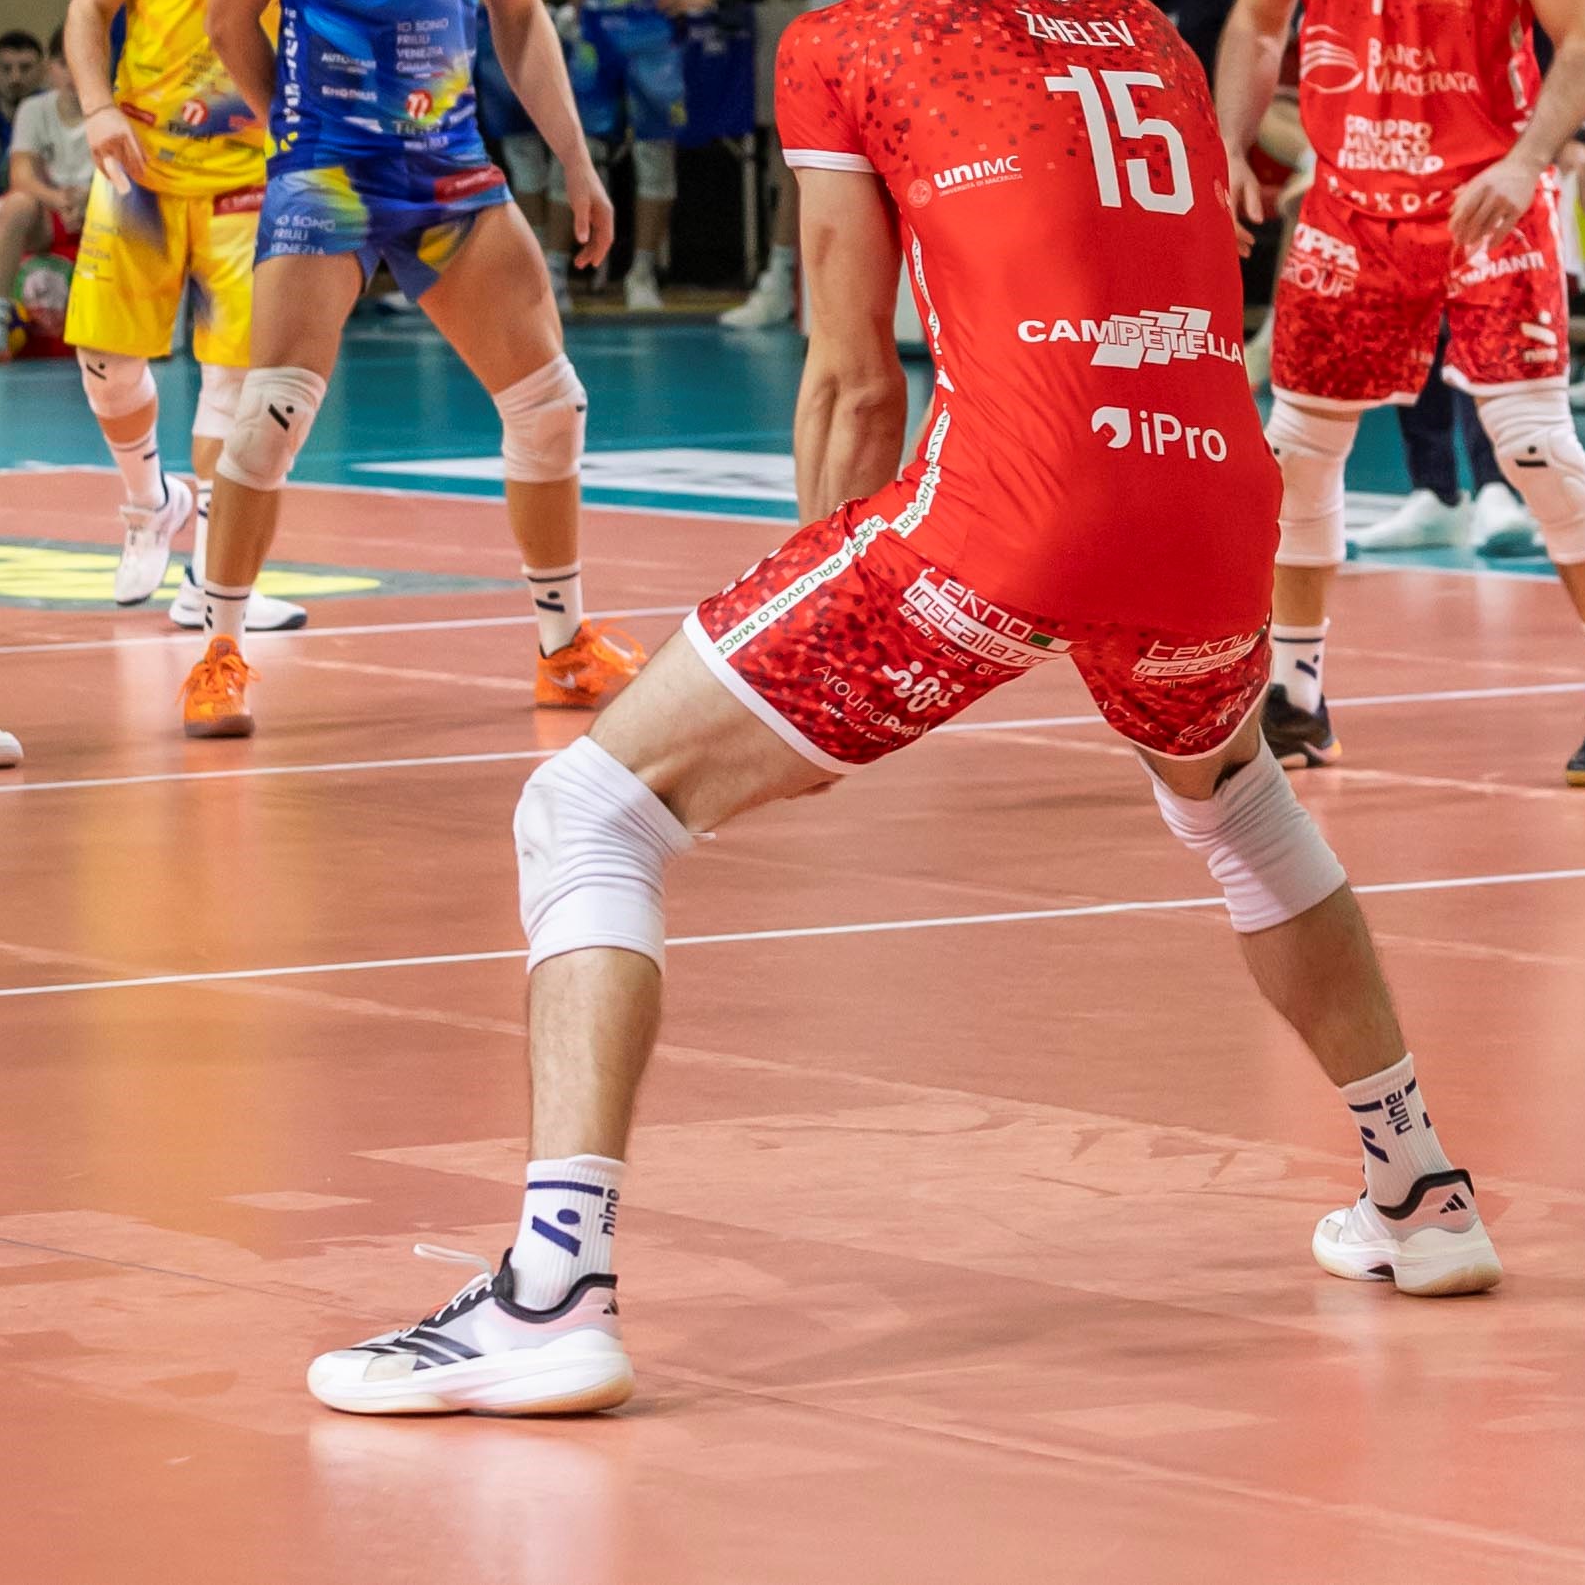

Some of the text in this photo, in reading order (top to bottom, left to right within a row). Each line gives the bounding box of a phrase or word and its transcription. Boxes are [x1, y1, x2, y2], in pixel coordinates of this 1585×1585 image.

[1017, 10, 1135, 48] ZHELEV
[1367, 37, 1436, 68] BANCA
[1366, 63, 1480, 96] MACERATA
[1044, 64, 1194, 215] 15
[1018, 318, 1243, 367] CAMPETELLA
[1140, 411, 1227, 463] iPro
